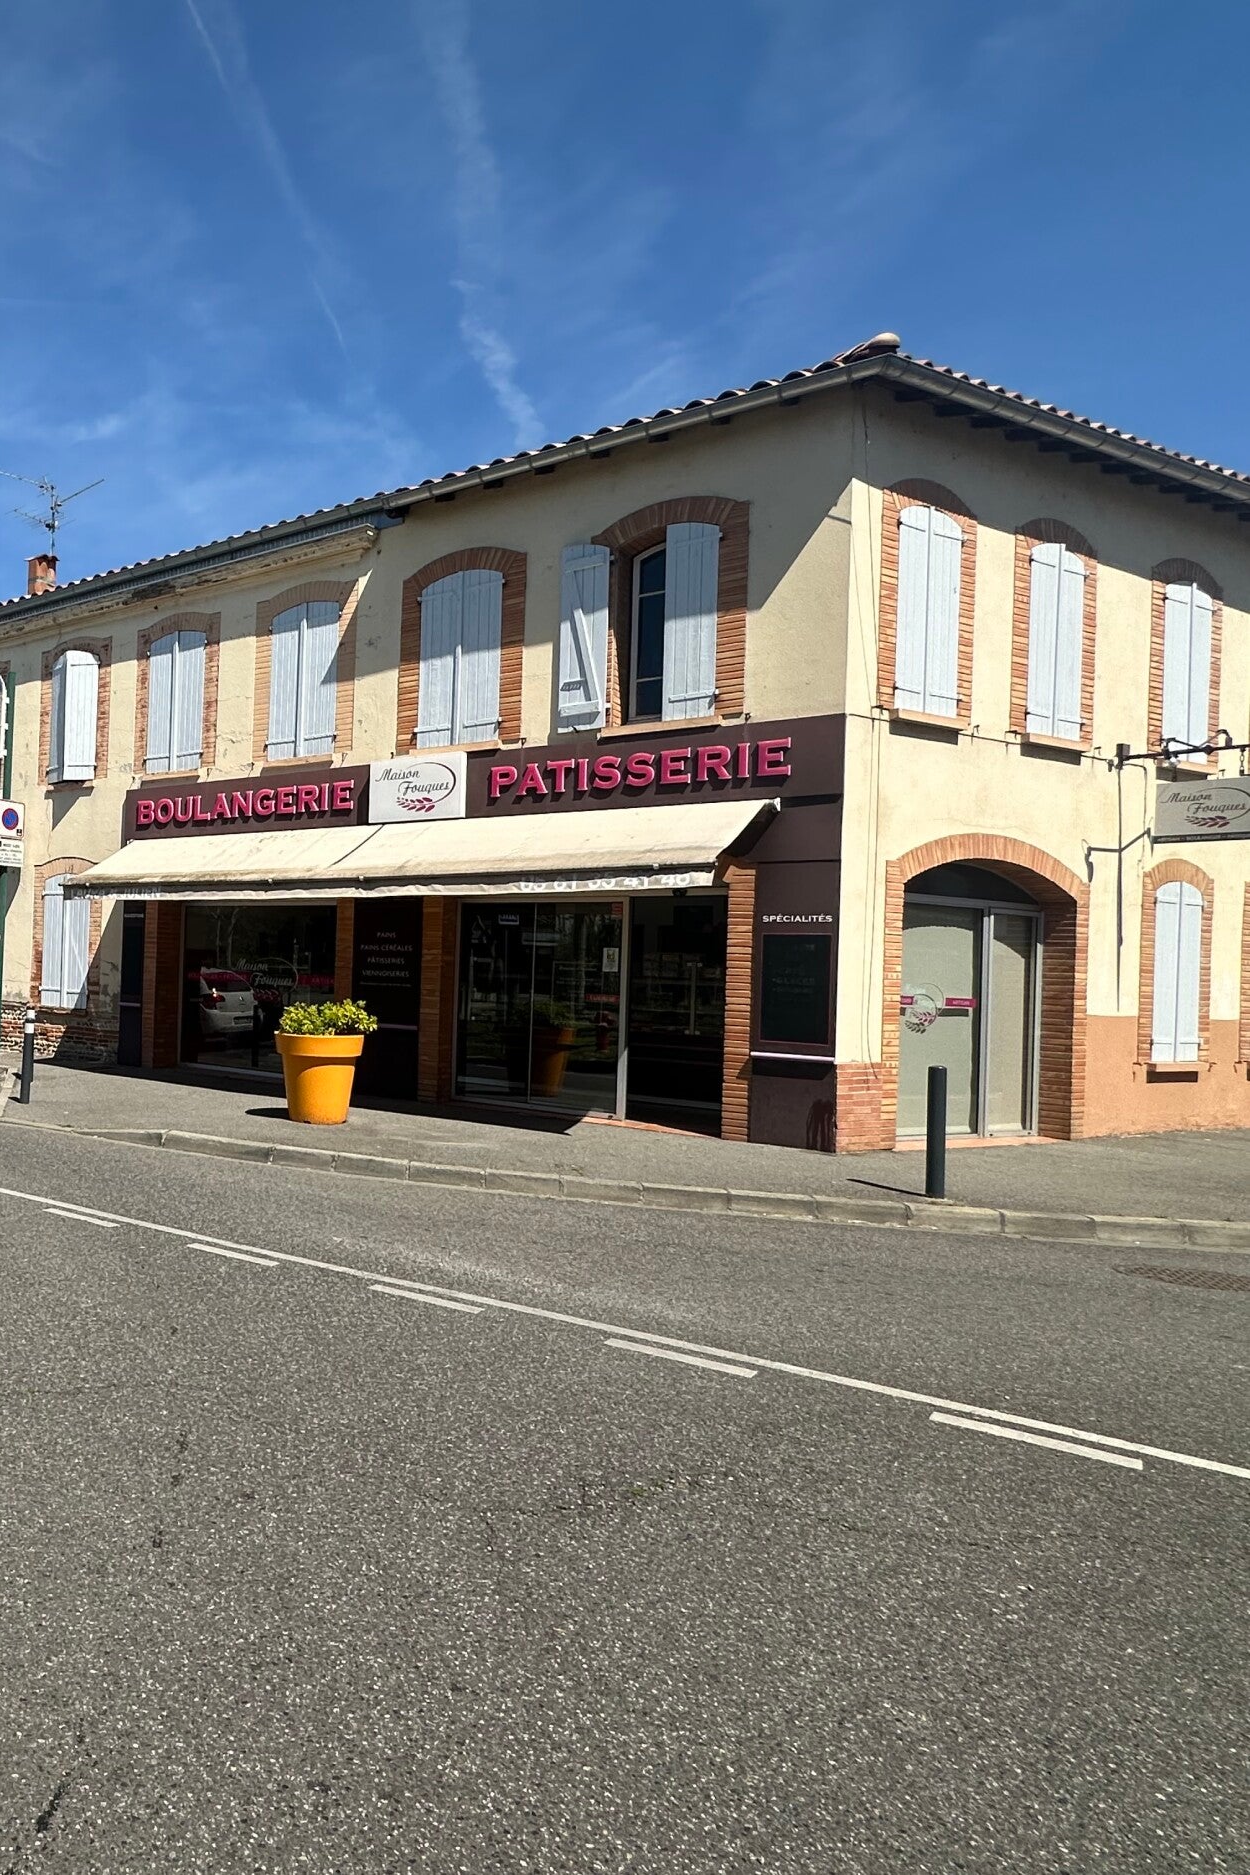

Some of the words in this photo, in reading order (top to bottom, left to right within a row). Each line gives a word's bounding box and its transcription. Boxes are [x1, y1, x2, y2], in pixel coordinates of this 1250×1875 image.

[489, 737, 792, 798] PATISSERIE
[375, 768, 420, 782] Maison
[398, 780, 450, 796] Fouques
[136, 779, 355, 825] BOULANGERIE
[1160, 792, 1212, 803] Maison
[1187, 802, 1247, 814] Fouques
[762, 912, 833, 923] SPÉCIALITÉS
[236, 958, 268, 972] Maison
[251, 973, 294, 987] Fouques
